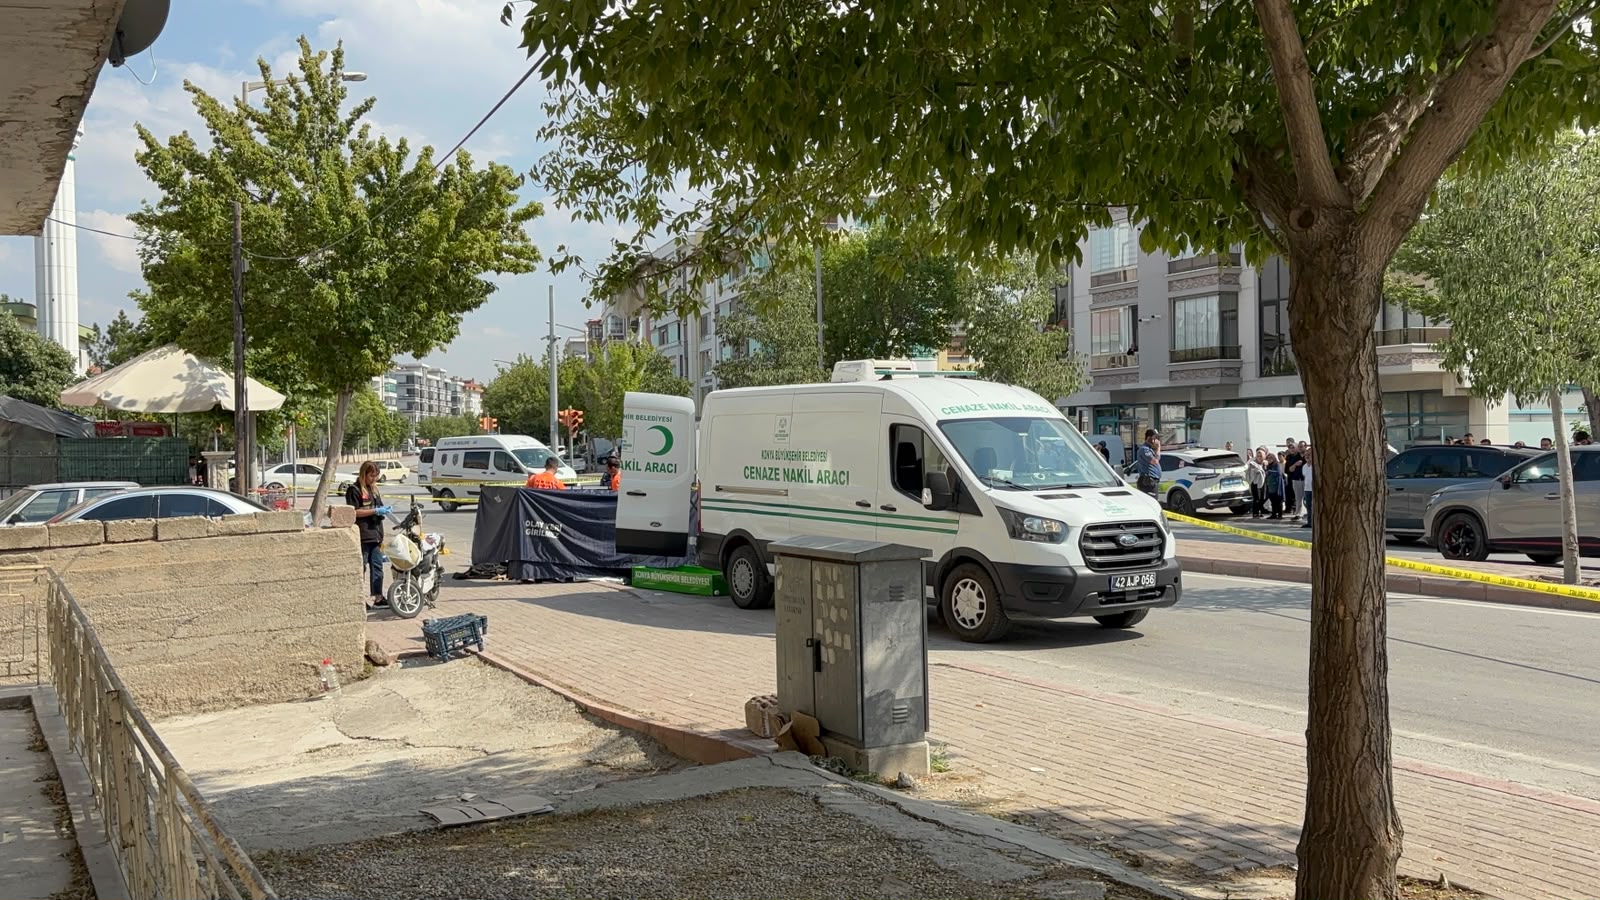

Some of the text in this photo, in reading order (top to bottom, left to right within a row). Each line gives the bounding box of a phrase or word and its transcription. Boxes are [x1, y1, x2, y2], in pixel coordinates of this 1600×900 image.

[941, 403, 986, 415] CENAZE
[1022, 404, 1052, 414] ARACI
[635, 414, 673, 422] BELEDİYESİ
[761, 449, 775, 460] KONYA
[644, 461, 678, 474] ARACI
[743, 465, 850, 485] CENAZE NAKİL ARACI
[525, 520, 544, 529] OLAY
[634, 571, 651, 580] KONYA
[680, 574, 710, 586] BELEDİYESİ
[1115, 574, 1154, 588] 42 AJP 056
